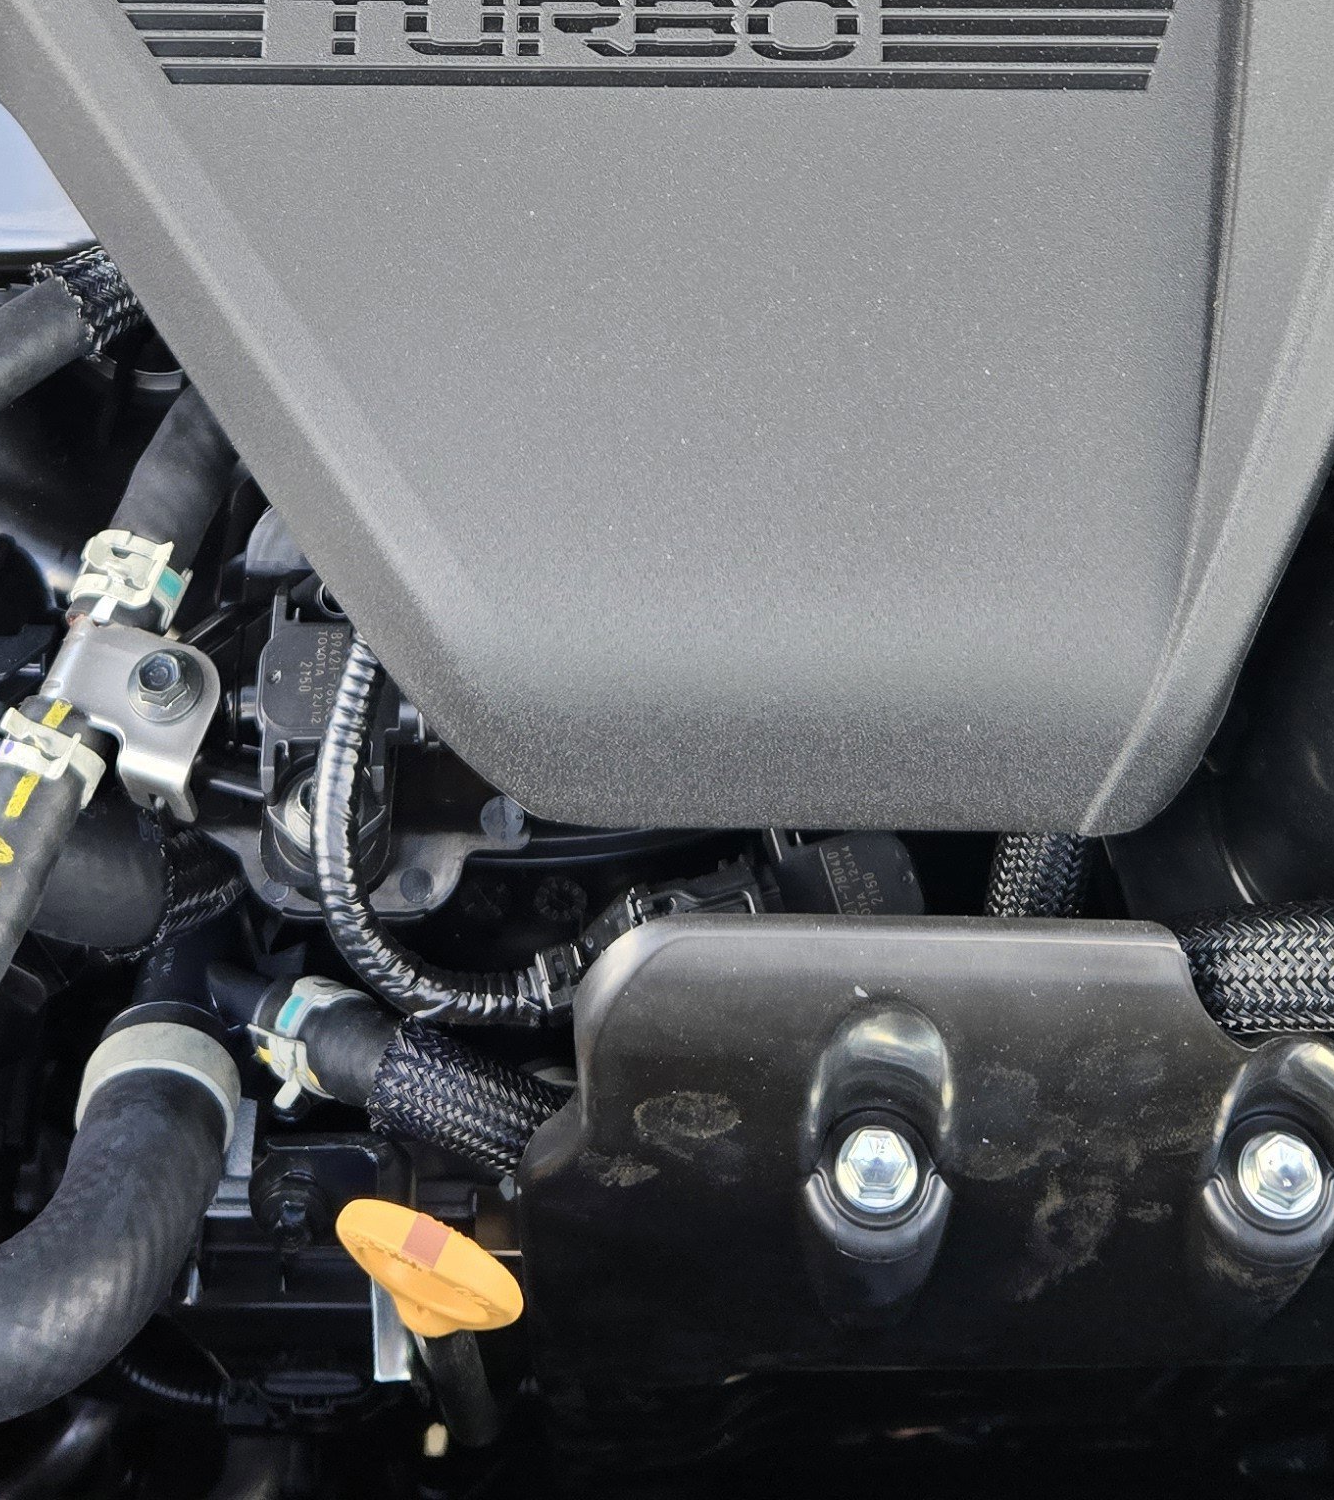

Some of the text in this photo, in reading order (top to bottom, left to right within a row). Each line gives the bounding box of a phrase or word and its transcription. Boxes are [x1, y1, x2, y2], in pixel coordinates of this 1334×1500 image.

[299, 661, 313, 692] 2150
[311, 630, 328, 724] TOYOTA 12J12
[862, 872, 884, 905] 2150
